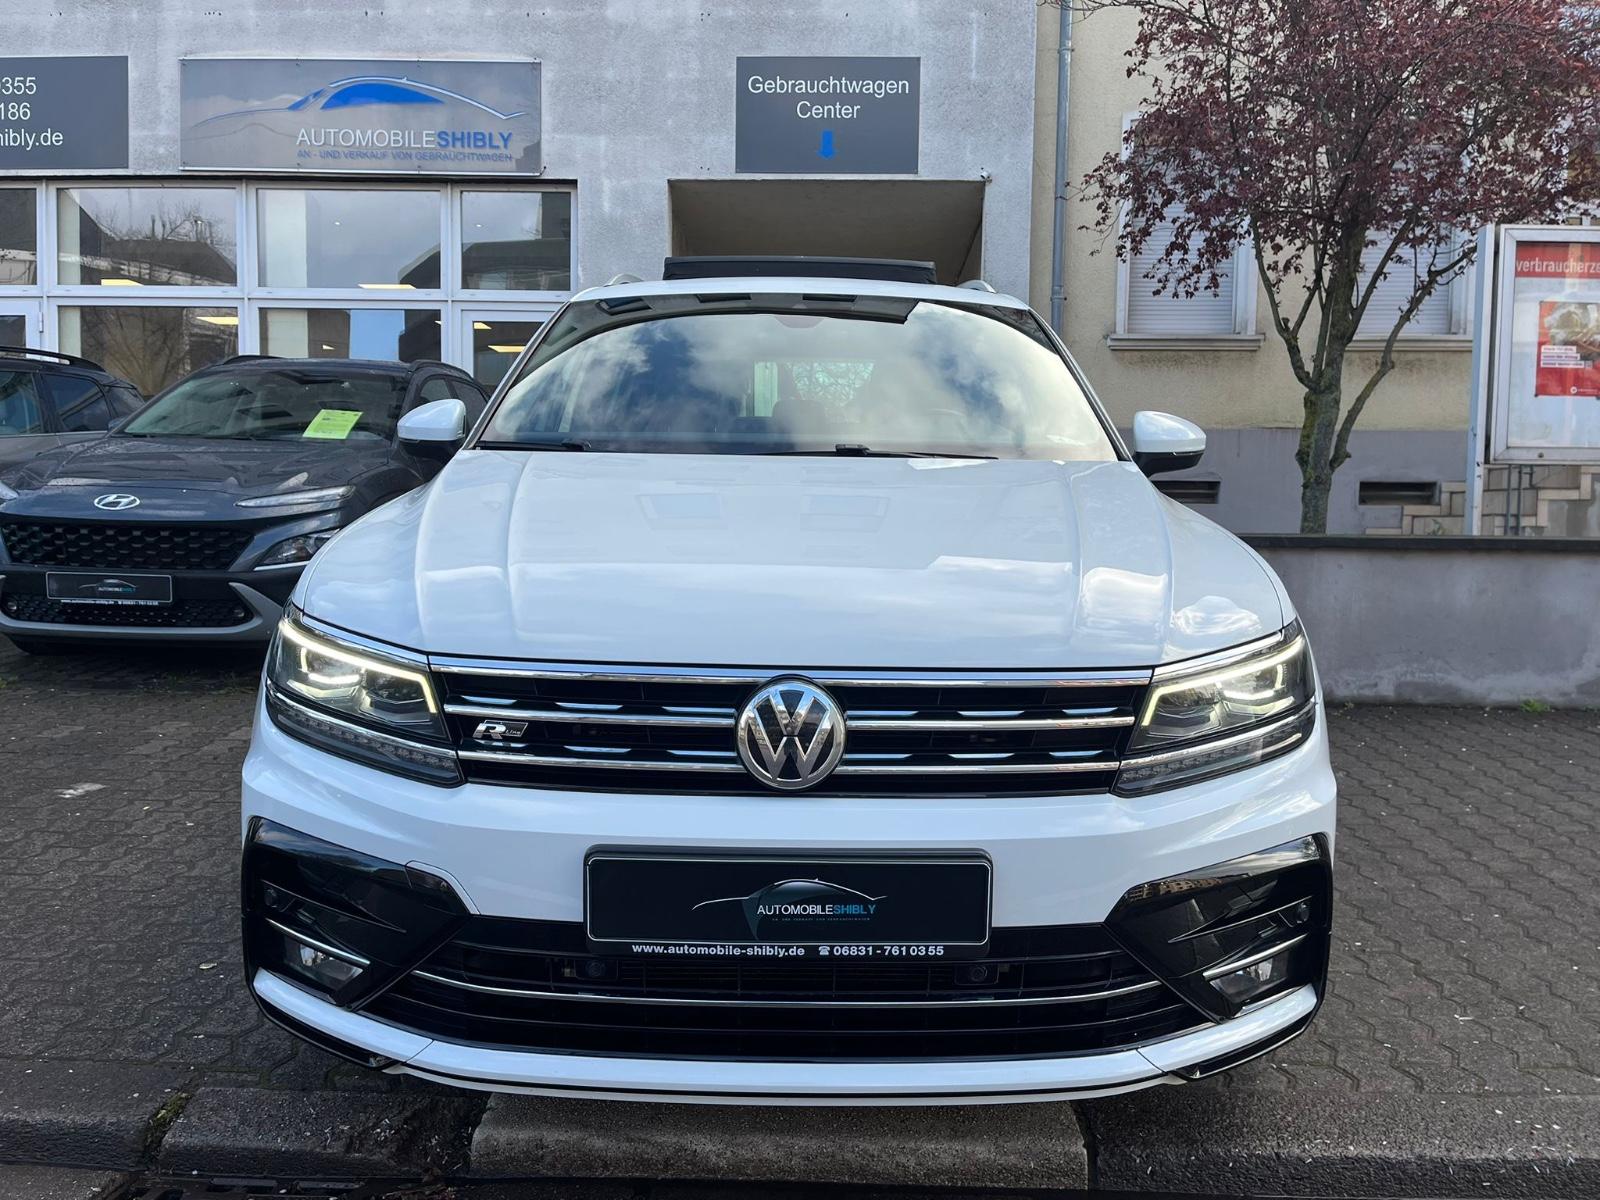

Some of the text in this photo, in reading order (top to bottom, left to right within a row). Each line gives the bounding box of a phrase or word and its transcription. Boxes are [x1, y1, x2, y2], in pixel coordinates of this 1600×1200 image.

[0, 76, 37, 95] 355
[747, 75, 910, 98] Gebrauchtwagen
[796, 100, 861, 119] Center
[342, 150, 389, 161] VERKAUF
[632, 943, 805, 957] www.automobile-shibly.de
